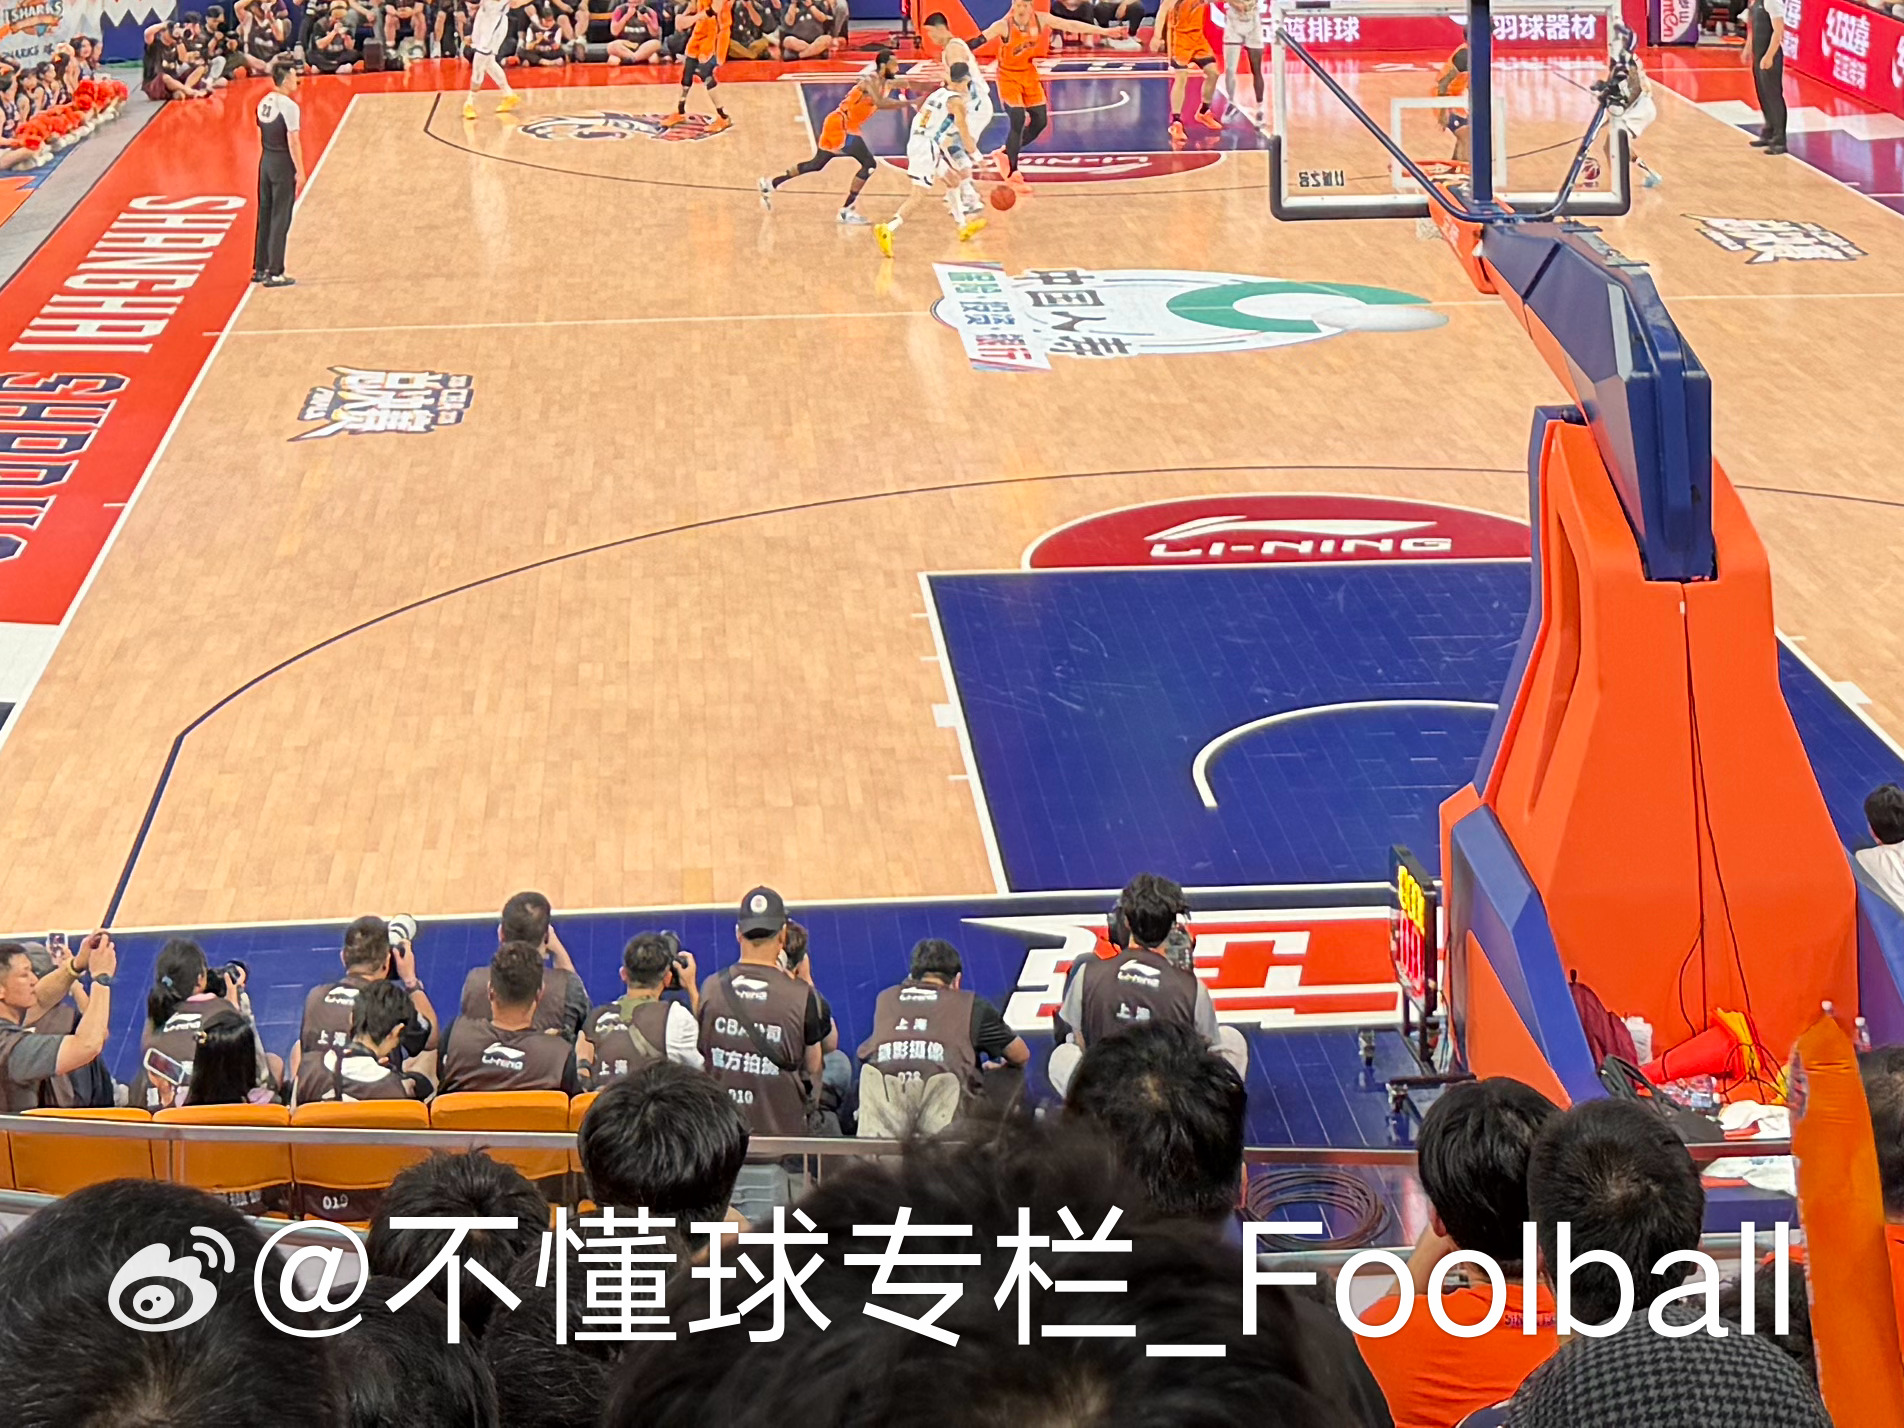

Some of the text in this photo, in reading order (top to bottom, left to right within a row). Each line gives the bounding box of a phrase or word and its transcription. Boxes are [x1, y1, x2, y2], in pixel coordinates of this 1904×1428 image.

[1494, 13, 1597, 41] 羽球器材
[9, 194, 248, 354] SHANGHAI
[1149, 536, 1454, 559] LI-NING
[896, 1017, 928, 1032] 上海
[598, 1059, 629, 1076] 上海
